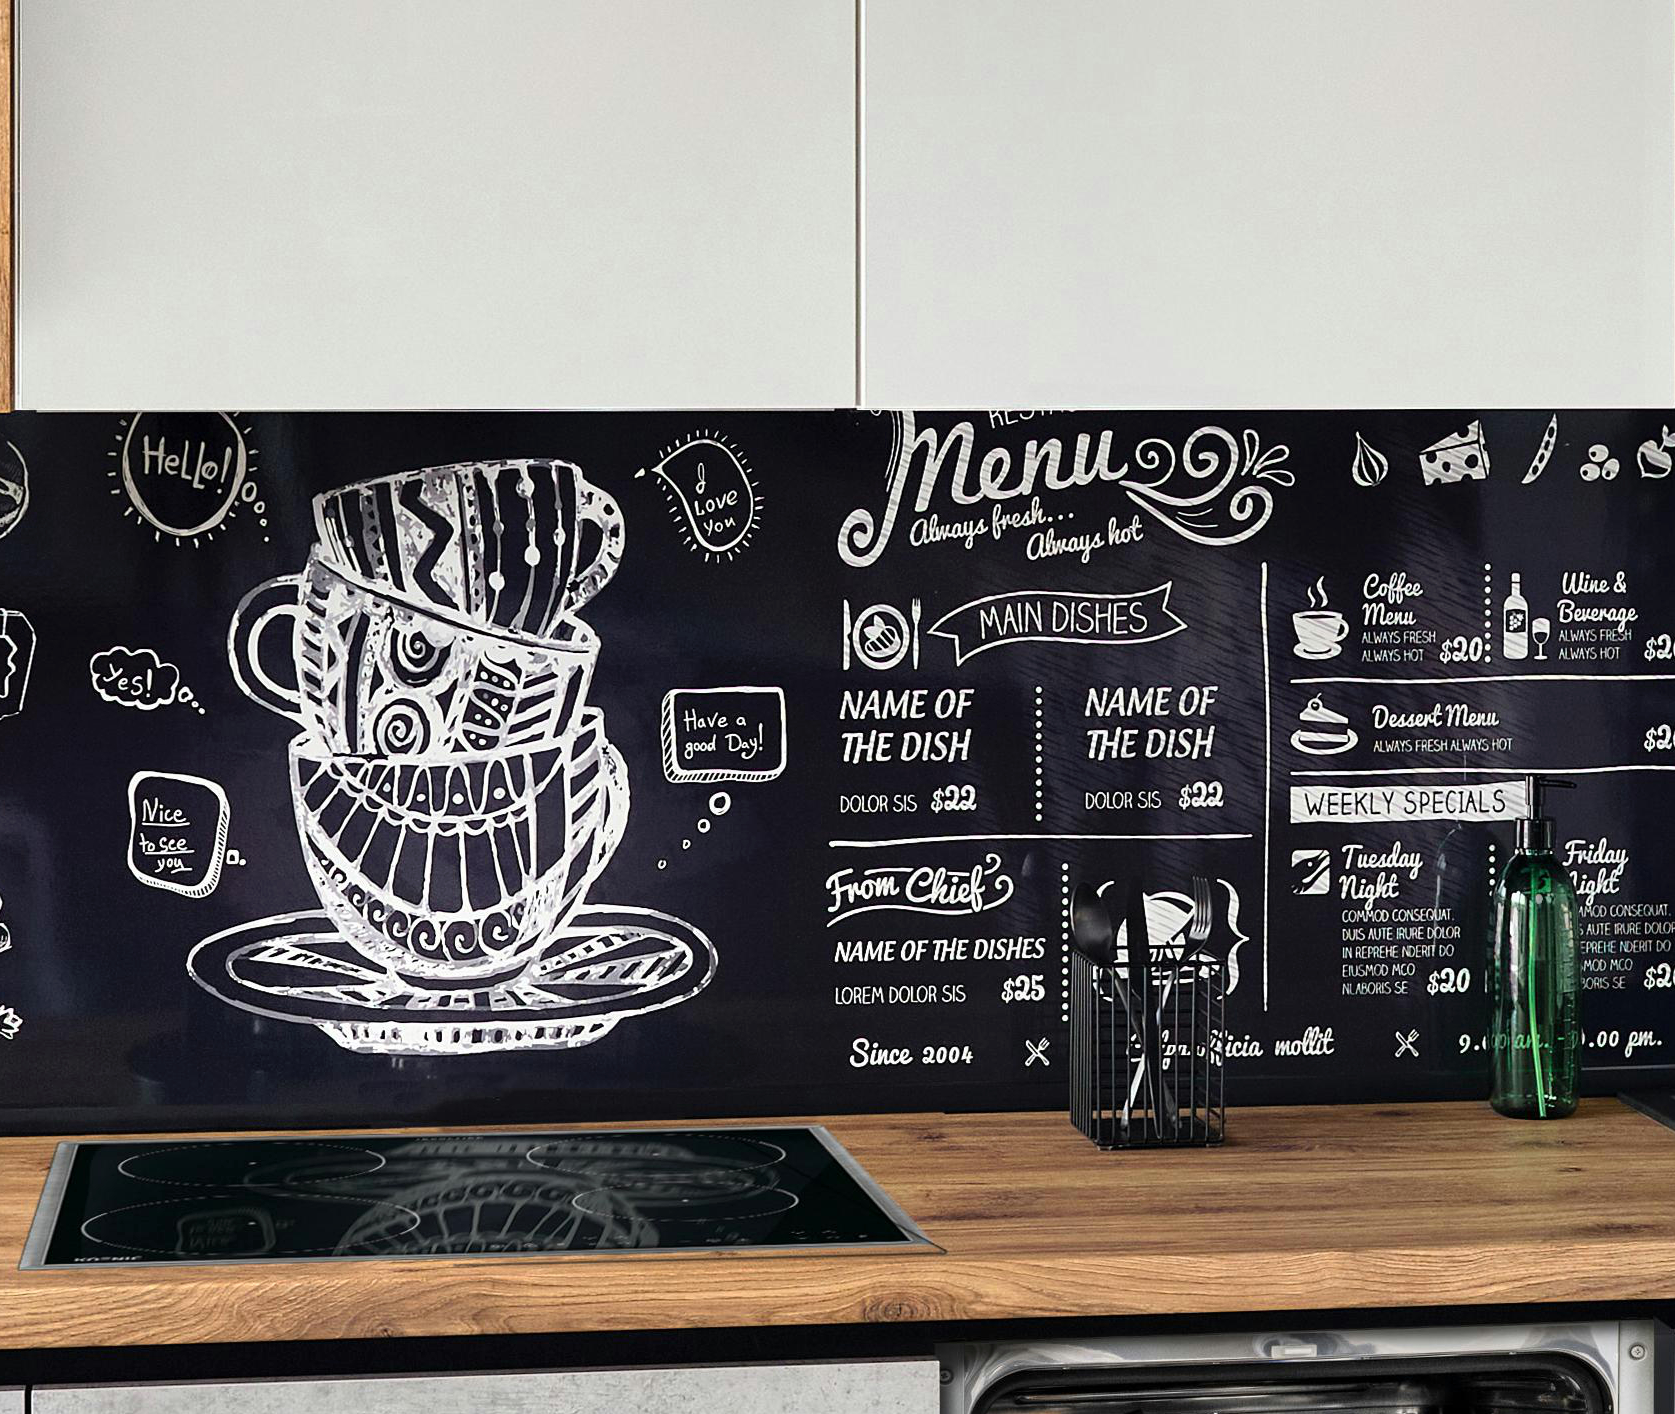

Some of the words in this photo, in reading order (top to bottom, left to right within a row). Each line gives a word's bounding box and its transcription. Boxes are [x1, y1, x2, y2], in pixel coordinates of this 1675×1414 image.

[838, 411, 1128, 567] Menu
[910, 510, 988, 549] Always
[1027, 528, 1105, 563] Always
[1109, 515, 1143, 545] hot
[1364, 572, 1423, 605] Coffee
[1563, 572, 1610, 594] Wine
[1613, 571, 1626, 593] &
[980, 606, 1042, 639] MAIN
[1053, 601, 1147, 634] DISHES
[1362, 602, 1416, 625] Menu
[1557, 599, 1638, 633] Beverage
[1362, 631, 1400, 643] ALWAYS
[1404, 630, 1436, 643] FRESH
[1559, 629, 1597, 641] ALWAYS
[1599, 628, 1633, 642] FRESH
[1362, 649, 1401, 661] ALWAYS
[1404, 649, 1423, 661] HOT
[1440, 636, 1483, 664] $20
[1559, 647, 1597, 659] ALWAYS
[1600, 647, 1620, 659] HOT
[840, 690, 928, 719] NAME
[935, 689, 974, 718] OF
[1085, 687, 1172, 716] NAME
[1179, 686, 1218, 716] OF
[684, 709, 728, 732] Have
[736, 717, 746, 726] a
[1372, 703, 1442, 729] Dessert
[1445, 704, 1499, 726] Menu
[685, 734, 716, 759] good
[725, 723, 763, 759] Day!
[842, 730, 894, 764] THE
[901, 729, 971, 762] DISH
[1087, 727, 1138, 760] THE
[1145, 726, 1215, 759] DISH
[1374, 740, 1412, 752] ALWAYS
[1415, 739, 1447, 752] FRESH
[1450, 739, 1489, 751] ALWAYS
[1492, 738, 1512, 751] HOT
[841, 795, 888, 813] DOLOR
[893, 795, 917, 812] SIS
[931, 785, 976, 813] $22
[1086, 792, 1132, 809] DOLOR
[1138, 791, 1161, 808] SIS
[1179, 781, 1223, 810] $22
[1304, 791, 1397, 816] WEEKLY
[1404, 789, 1506, 815] SPECIALS
[142, 797, 187, 822] Nice
[1341, 841, 1424, 880] Tuesday
[1562, 837, 1629, 876] Friday
[825, 868, 900, 913] From
[904, 866, 986, 914] Chief
[1339, 872, 1400, 910] Night
[1341, 909, 1389, 923] COMMOD
[1391, 908, 1455, 922] CONSEQUAT.
[1609, 904, 1672, 917] CONSEQUAT.
[1343, 928, 1365, 941] DUIS
[1368, 927, 1392, 940] AUTE
[1397, 927, 1424, 940] IRURE
[1427, 926, 1461, 939] DOLOR
[1587, 923, 1610, 935] AUTE
[1615, 923, 1641, 934] IRURE
[835, 941, 896, 962] NAME
[901, 940, 928, 961] OF
[933, 938, 969, 961] THE
[974, 937, 1046, 960] DISHES
[1343, 947, 1352, 958] IN
[1356, 946, 1398, 959] REPREHE
[1401, 945, 1435, 958] NDERIT
[1439, 944, 1454, 957] DO
[1581, 941, 1616, 954] EPREHE
[1620, 940, 1652, 952] NDERIT
[1657, 940, 1671, 952] DO
[1343, 964, 1388, 977] EIUSMOD
[1392, 963, 1415, 976] MCO
[1610, 959, 1633, 971] MCO
[836, 986, 884, 1004] LOREM
[889, 986, 937, 1003] DOLOR
[942, 985, 966, 1002] SIS
[1002, 975, 1045, 1003] $25
[1394, 981, 1407, 994] SE
[1427, 968, 1470, 995] $20
[1612, 977, 1625, 988] SE
[850, 1038, 913, 1067] Since
[922, 1046, 973, 1064] 2004
[1275, 1026, 1334, 1056] mollit
[1624, 1030, 1663, 1058] pm.
